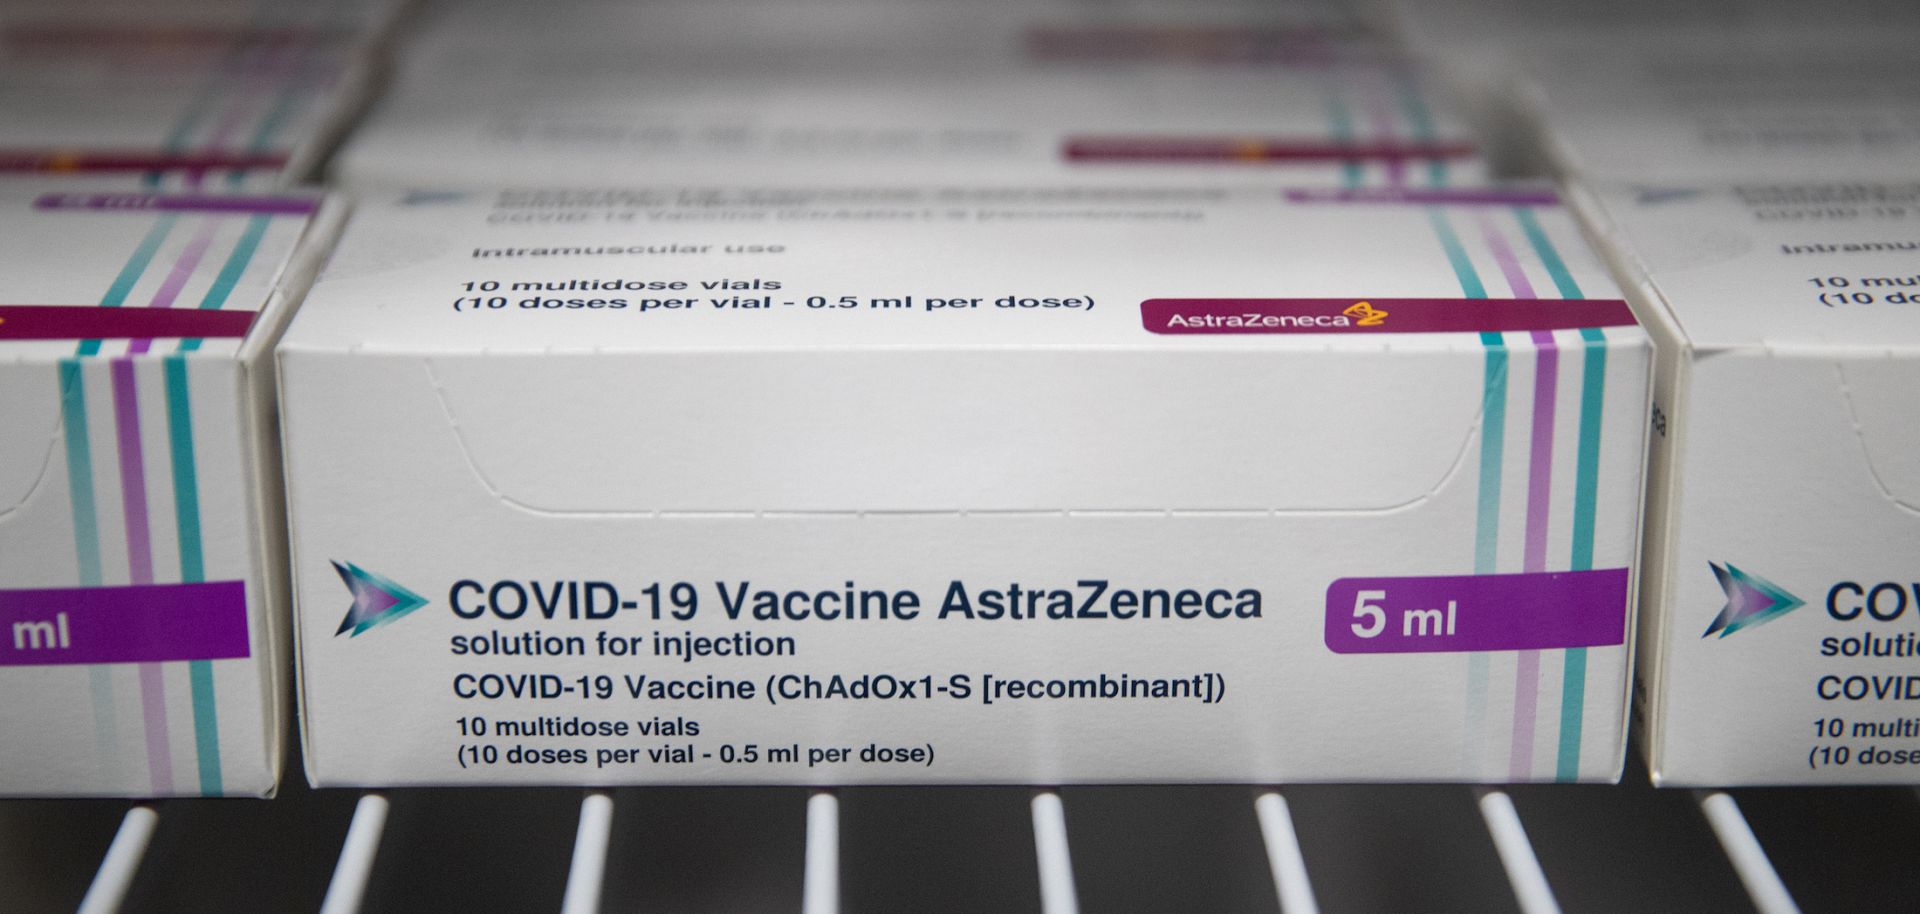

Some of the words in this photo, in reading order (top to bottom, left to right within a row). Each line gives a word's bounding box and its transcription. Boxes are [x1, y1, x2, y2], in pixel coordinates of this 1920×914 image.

[471, 244, 713, 259] Intramuscular
[724, 244, 786, 255] use
[464, 281, 499, 291] 10
[512, 280, 687, 291] multidose
[701, 279, 781, 290] vials
[1809, 277, 1849, 287] 10
[454, 297, 507, 311] (10
[519, 297, 627, 308] doses
[640, 299, 698, 312] per
[711, 296, 770, 308] vial
[807, 296, 857, 308] 0.5
[871, 296, 911, 308] ml
[926, 299, 983, 311] per
[995, 296, 1094, 310] dose)
[1819, 293, 1873, 307] (10
[1167, 313, 1349, 328] AstraZeneca
[449, 580, 697, 621] COVID-19
[716, 581, 920, 621] Vaccine
[938, 580, 1262, 620] AstraZeneca
[1351, 591, 1385, 638] 5
[1404, 601, 1456, 636] ml
[14, 613, 69, 648] ml
[451, 630, 584, 656] solution
[596, 631, 642, 656] for
[654, 631, 795, 662] injection
[454, 674, 613, 699] COVID-19
[624, 675, 755, 699] Vaccine
[767, 674, 971, 705] (ChAdOx1-S
[983, 673, 1225, 704] [recombinant])
[457, 717, 486, 736] 10
[496, 717, 629, 736] multidose
[638, 717, 699, 736] vials
[1814, 718, 1844, 738] 10
[458, 745, 497, 768] (10
[506, 745, 587, 764] doses
[597, 749, 639, 768] per
[648, 744, 693, 763] vial
[720, 745, 758, 763] 0.5
[768, 744, 798, 762] ml
[809, 748, 851, 767] per
[860, 744, 934, 767] dose)
[1809, 746, 1850, 769] (10
